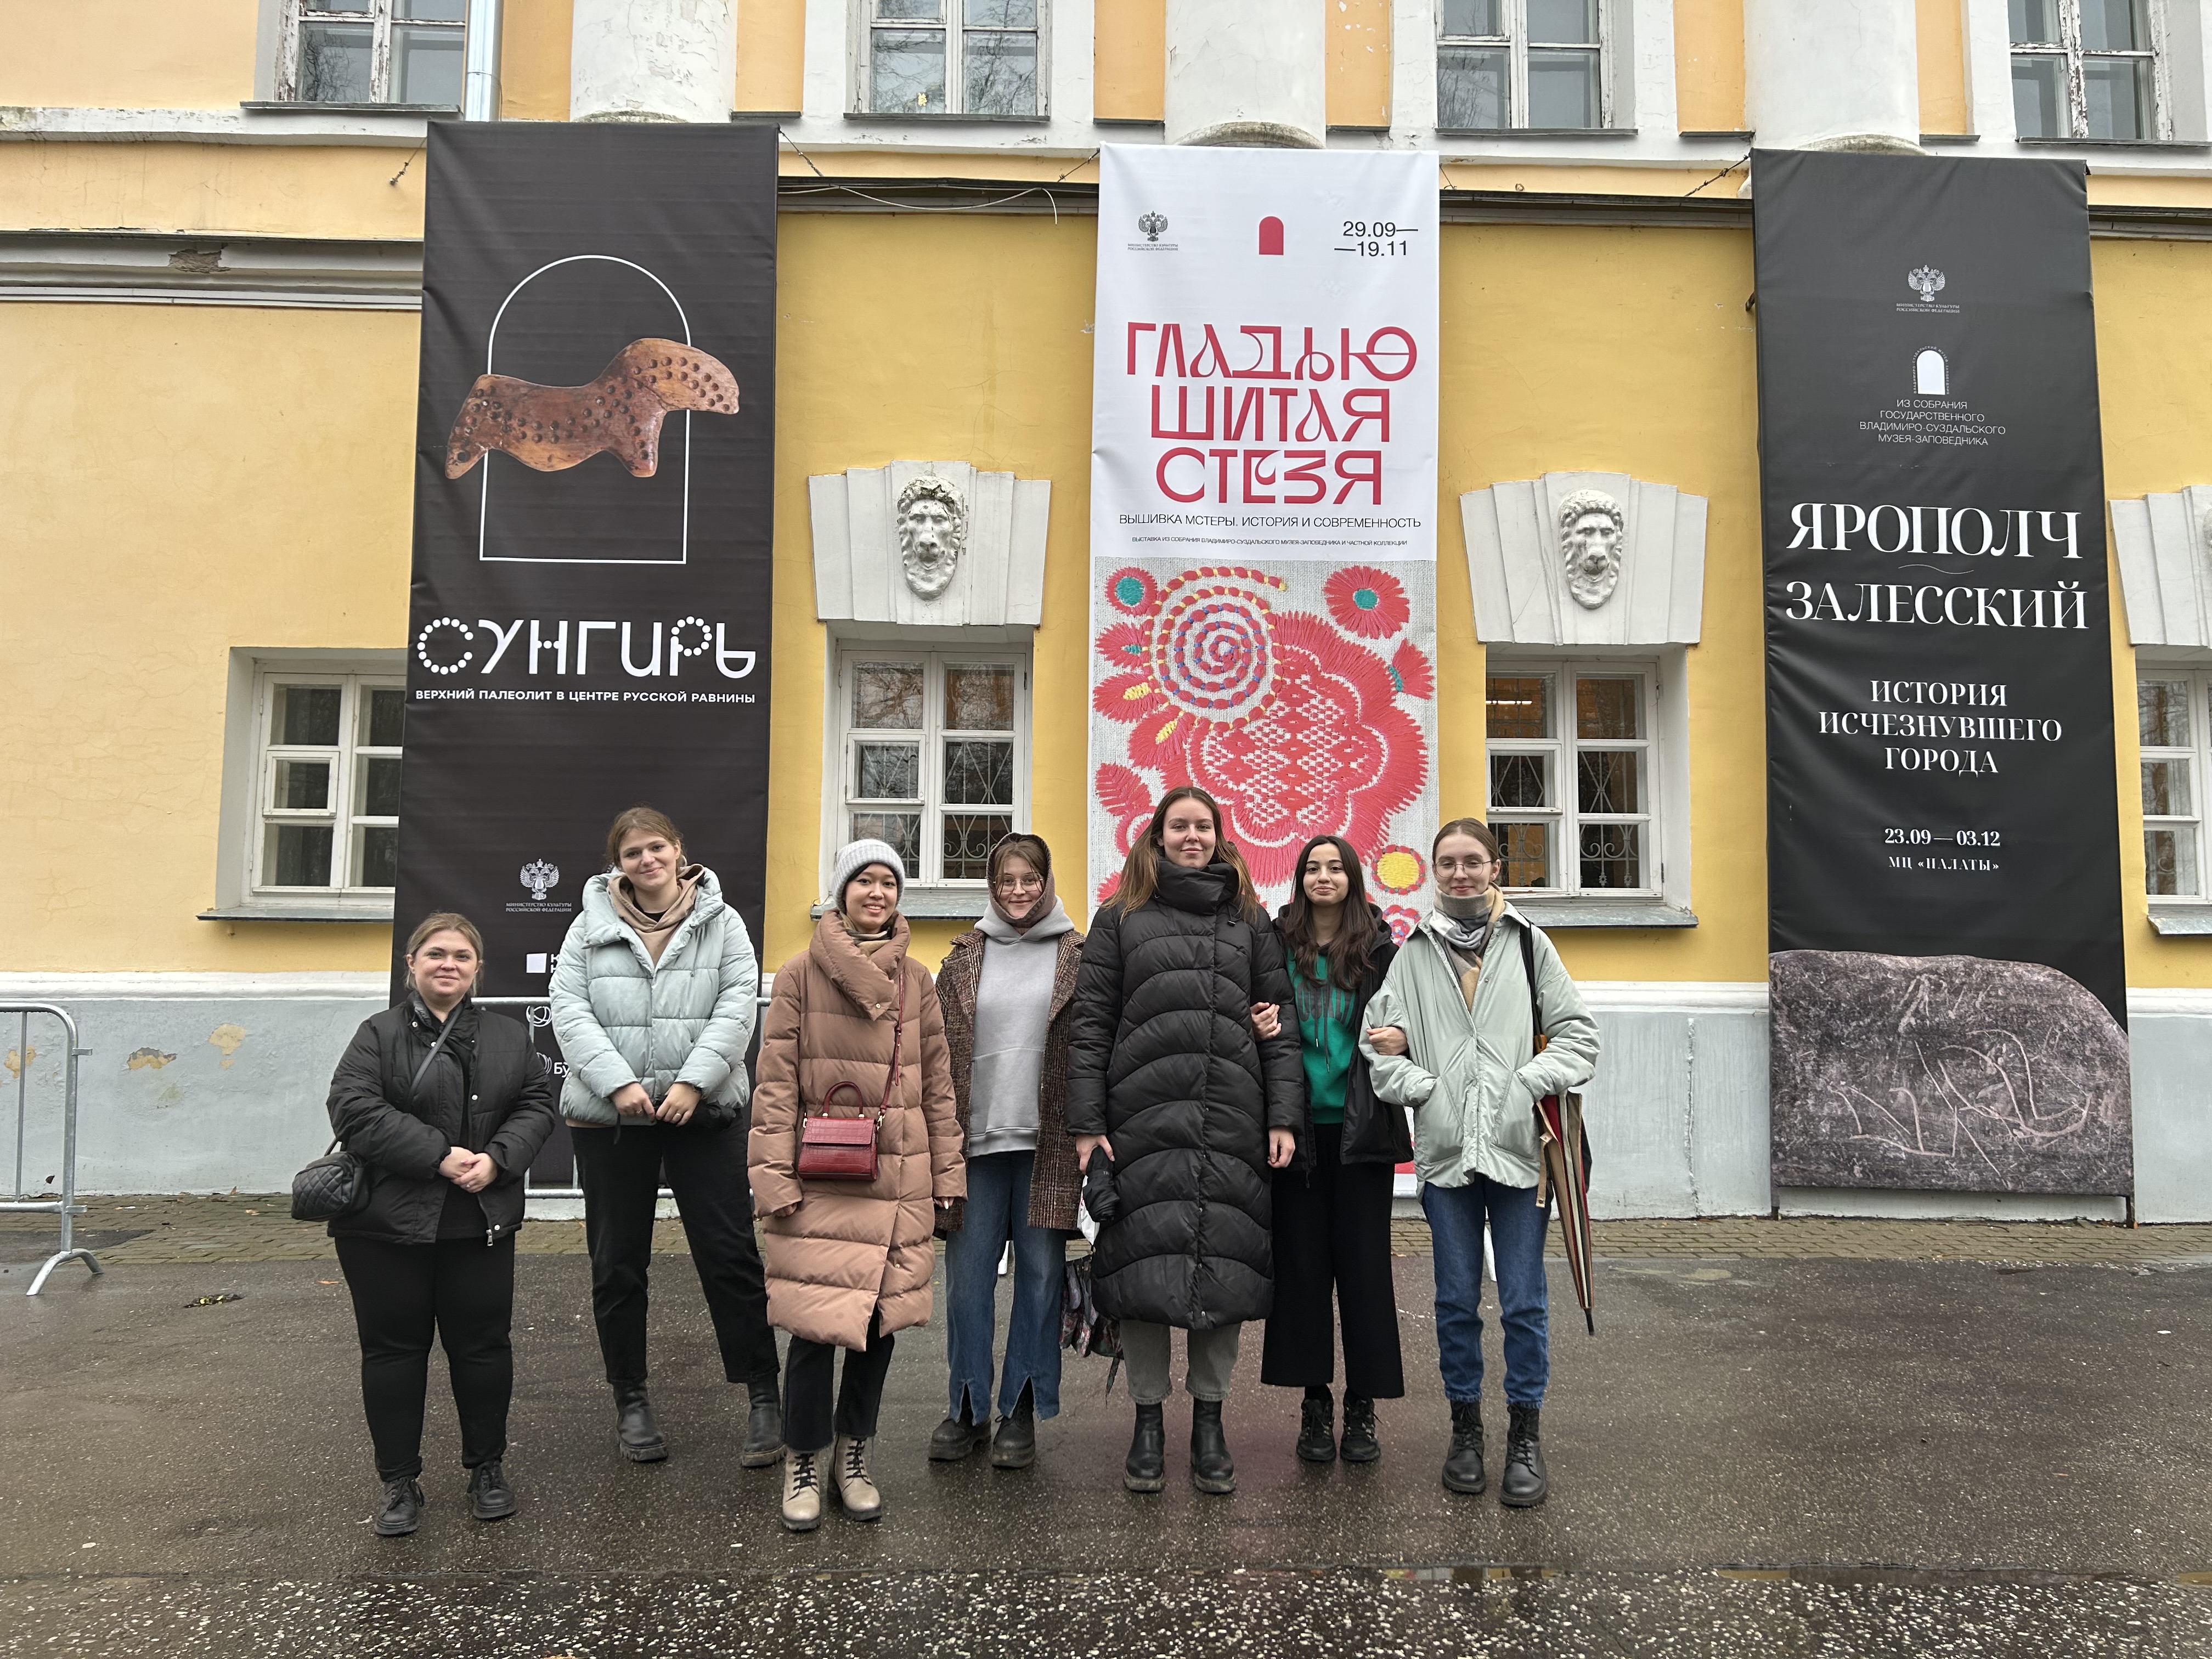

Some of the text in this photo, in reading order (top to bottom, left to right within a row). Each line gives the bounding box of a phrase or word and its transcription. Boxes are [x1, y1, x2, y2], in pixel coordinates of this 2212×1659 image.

[1127, 321, 1418, 382] ГЛАДЬЮ
[1151, 384, 1390, 443] ШИТАЯ
[1880, 410, 1984, 422] ГОСУДАРСТВЕННОГО
[1897, 399, 1967, 409] ИЗ СОБРАНИЯ
[1860, 421, 2006, 435] ВЛАДИМИРО-СУЗДАЛЬСКОГО
[1878, 434, 1988, 445] МУЗЕЯ-ЗАПОВЕДНИКА
[1156, 447, 1382, 505] СТЕЗЯ
[1120, 514, 1421, 528] ВЫШИВКА МСТЕРЫ. ИСТОРИЯ И СОВРЕМЕННОСТЬ
[1786, 503, 2083, 558] ЯРОПОЛЧ
[1786, 580, 2089, 629] ЗАЛЕССКИЙ
[417, 616, 756, 679] СУНГИРЬ
[416, 688, 755, 703] ВЕРХНИЙ ПАЛЕОЛИТ В ЦЕНТРЕ РУССКОЙ РАВНИНЫ
[1870, 680, 2007, 707] ИСТОРИЯ
[1818, 712, 2062, 741] ИСЧЕЗНУВШЕГО
[1884, 747, 1999, 777] ГОРОДА
[1889, 856, 1999, 871] МЦ «ПАЛАТЫ»
